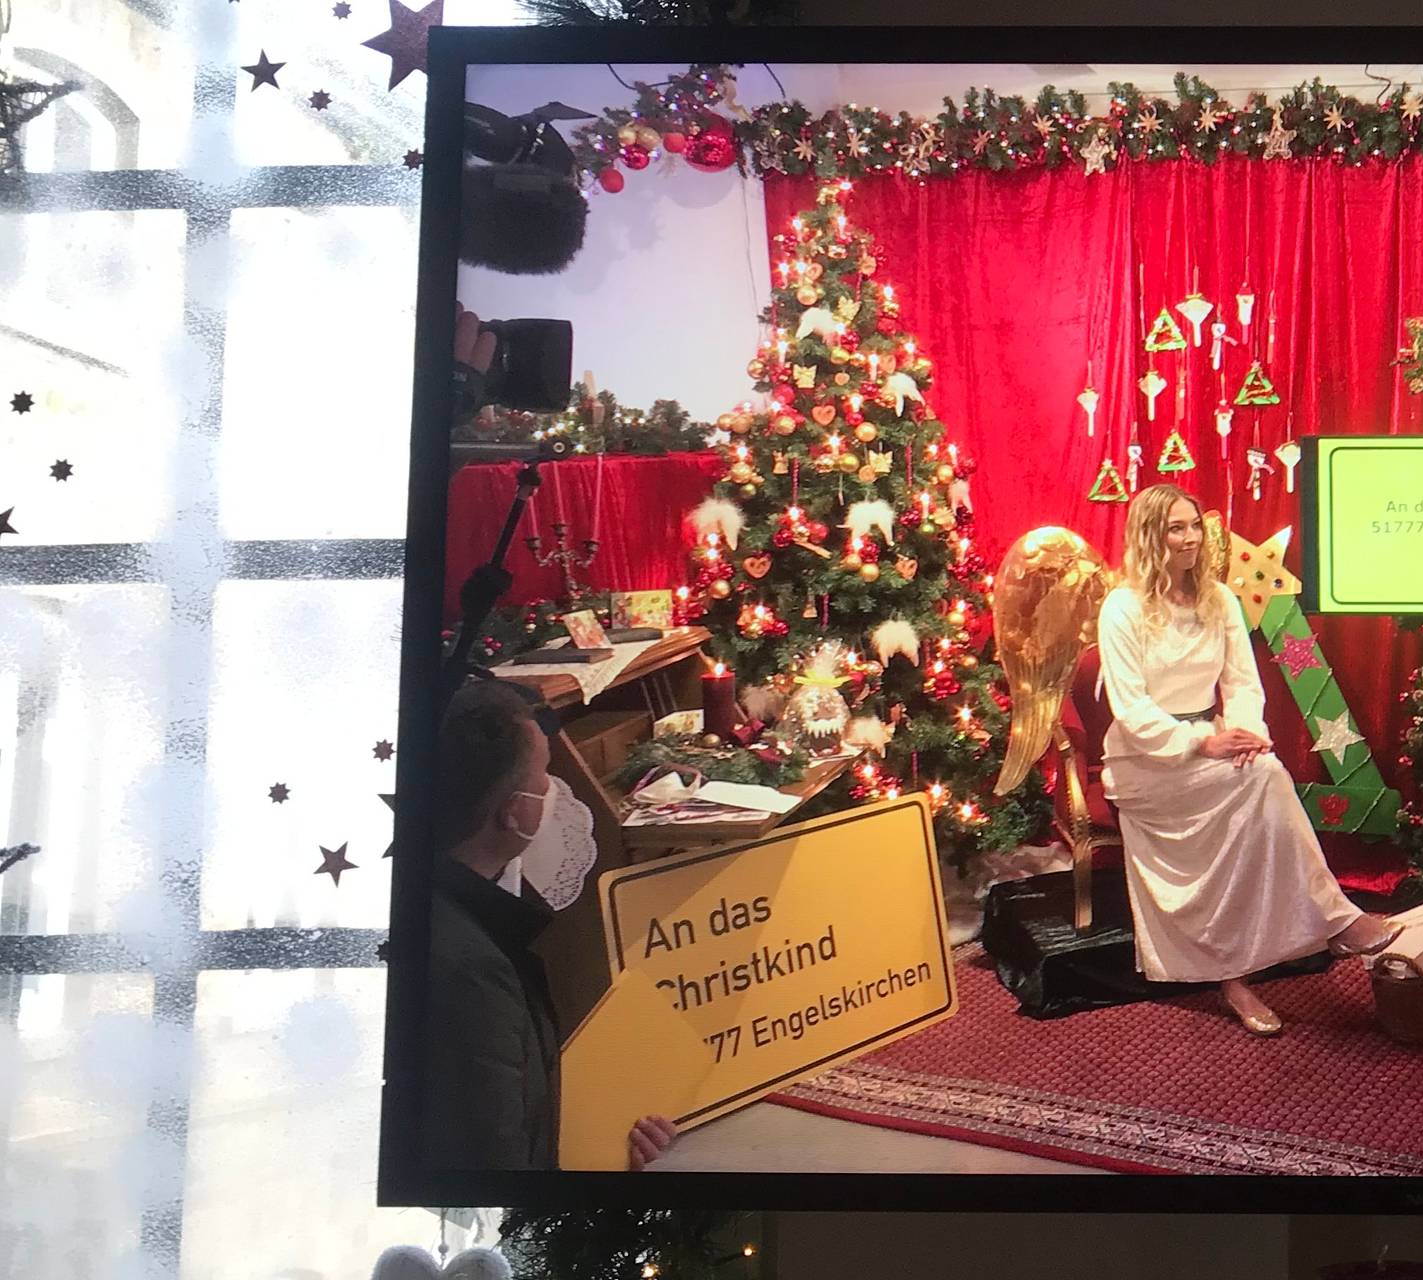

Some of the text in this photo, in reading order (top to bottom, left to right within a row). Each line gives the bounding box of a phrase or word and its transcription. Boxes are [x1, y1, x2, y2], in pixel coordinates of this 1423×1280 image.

[1386, 501, 1408, 513] An
[644, 893, 773, 960] An das
[751, 960, 932, 1048] Engelskirchen
